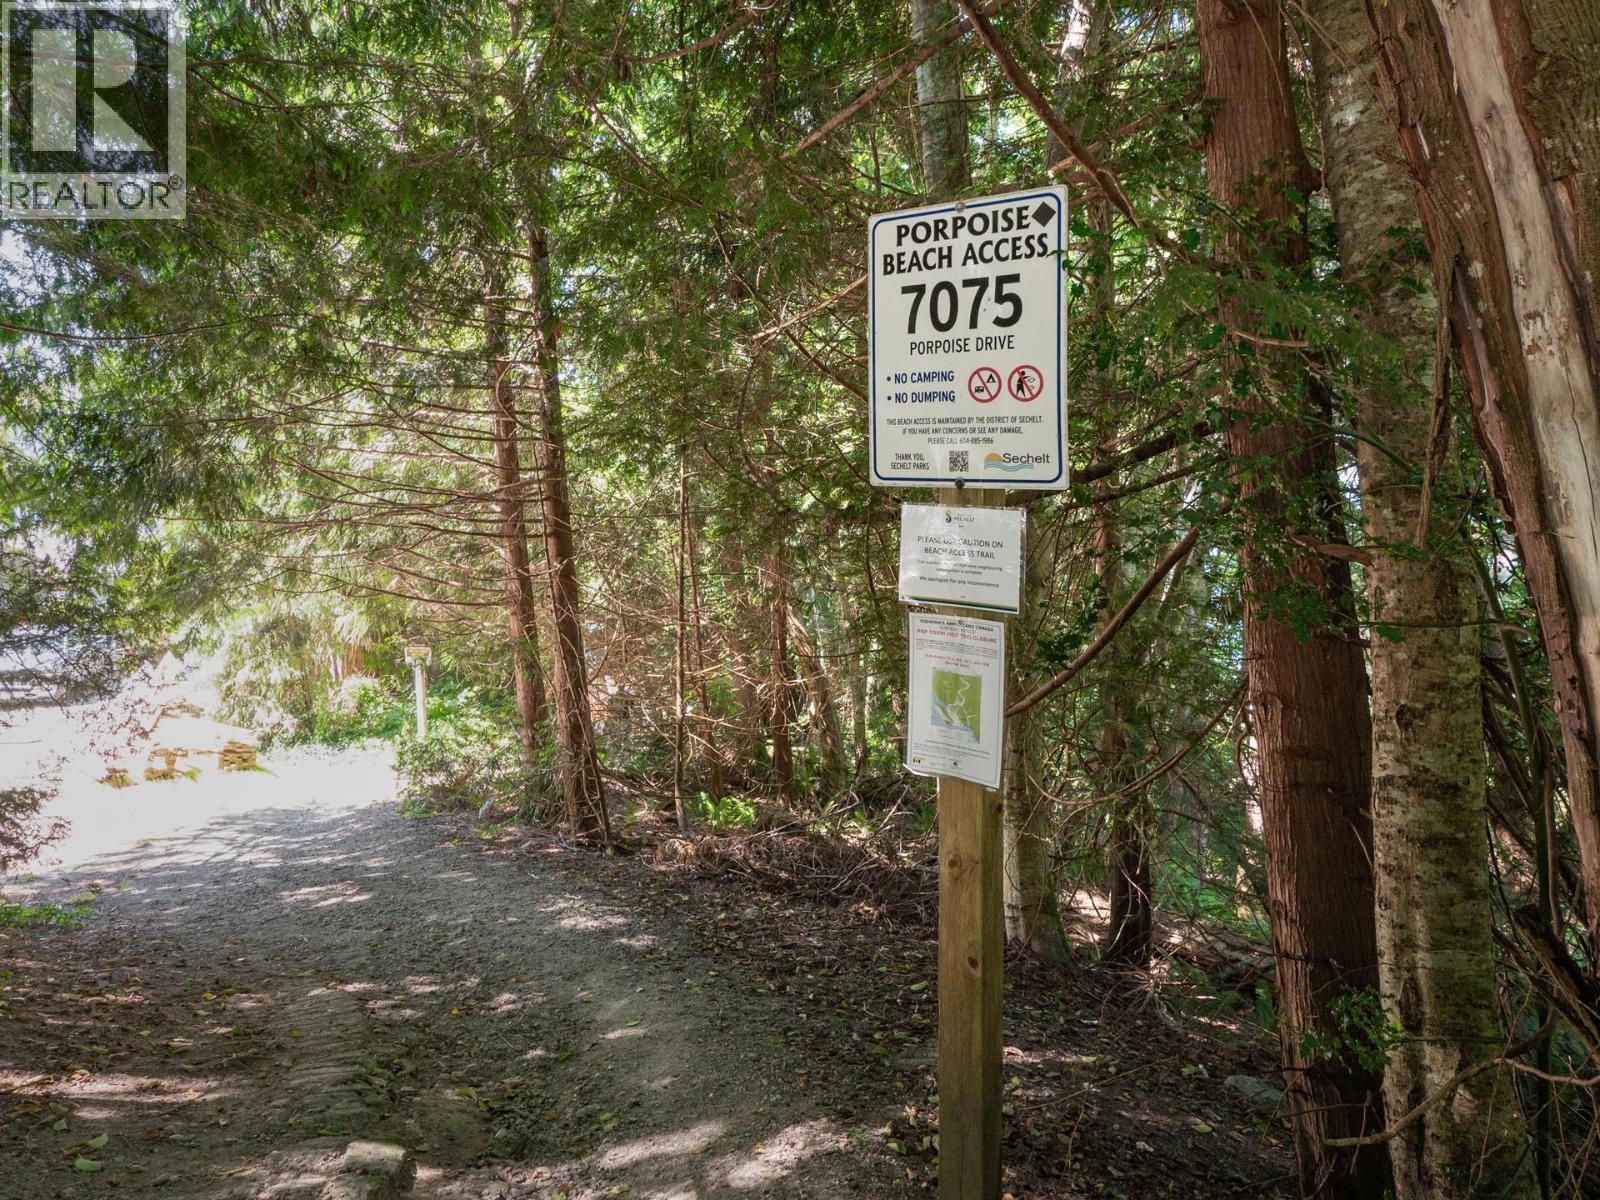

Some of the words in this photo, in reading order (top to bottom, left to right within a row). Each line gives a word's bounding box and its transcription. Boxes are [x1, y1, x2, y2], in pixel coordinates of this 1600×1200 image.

[896, 205, 1031, 247] PORPOISE
[882, 245, 953, 276] BEACH
[961, 233, 1049, 267] ACCESS
[901, 273, 1023, 334] 7075
[910, 338, 971, 356] PORPOISE
[975, 335, 1015, 352] DRIVE
[894, 373, 908, 384] NO
[910, 370, 955, 384] CAMPING
[894, 392, 908, 404] NO
[910, 390, 956, 403] DUMPING
[913, 417, 931, 425] ACCESS
[937, 416, 967, 424] MAINTAINED
[967, 416, 974, 424] BY
[975, 416, 985, 424] THE
[986, 415, 1009, 424] DISTRICT
[1010, 415, 1018, 423] OF
[908, 427, 918, 435] YOU
[918, 427, 931, 435] HAVE
[987, 426, 999, 434] ANY
[927, 437, 945, 445] PLEASE
[946, 437, 958, 445] CALL
[895, 453, 912, 461] THANK
[1002, 452, 1051, 464] Sechelt
[890, 462, 912, 470] SECHELT
[912, 462, 930, 470] PARKS
[992, 540, 1004, 549] ON
[977, 550, 996, 559] TRAIL
